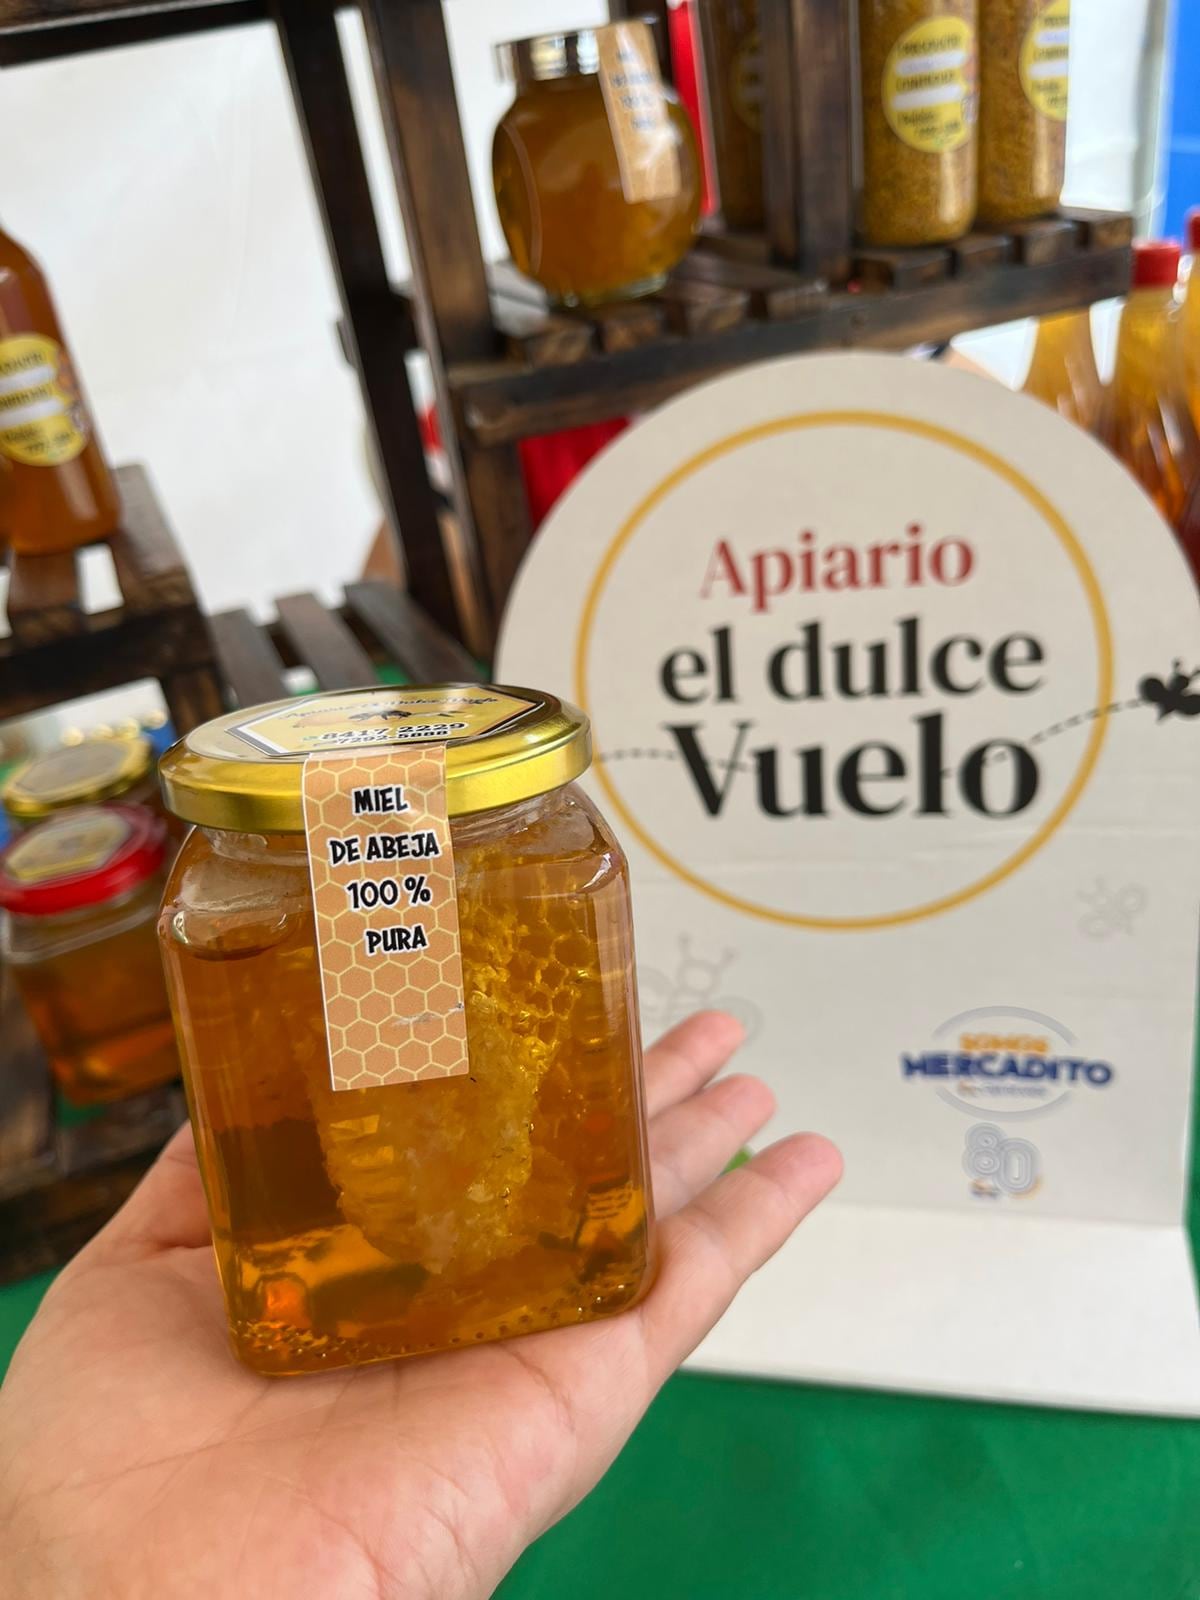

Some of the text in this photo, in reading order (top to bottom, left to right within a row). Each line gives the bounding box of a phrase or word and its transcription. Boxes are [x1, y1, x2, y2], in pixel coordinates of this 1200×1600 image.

[699, 525, 976, 613] Apiario
[659, 616, 1043, 704] el dulce
[398, 722, 466, 733] 2229
[665, 712, 1042, 821] Vuelo
[353, 786, 408, 814] MIEL
[329, 831, 440, 865] DE ABEJA
[346, 876, 431, 909] 100 %
[365, 925, 427, 954] PURA
[962, 1121, 1042, 1195] 80
